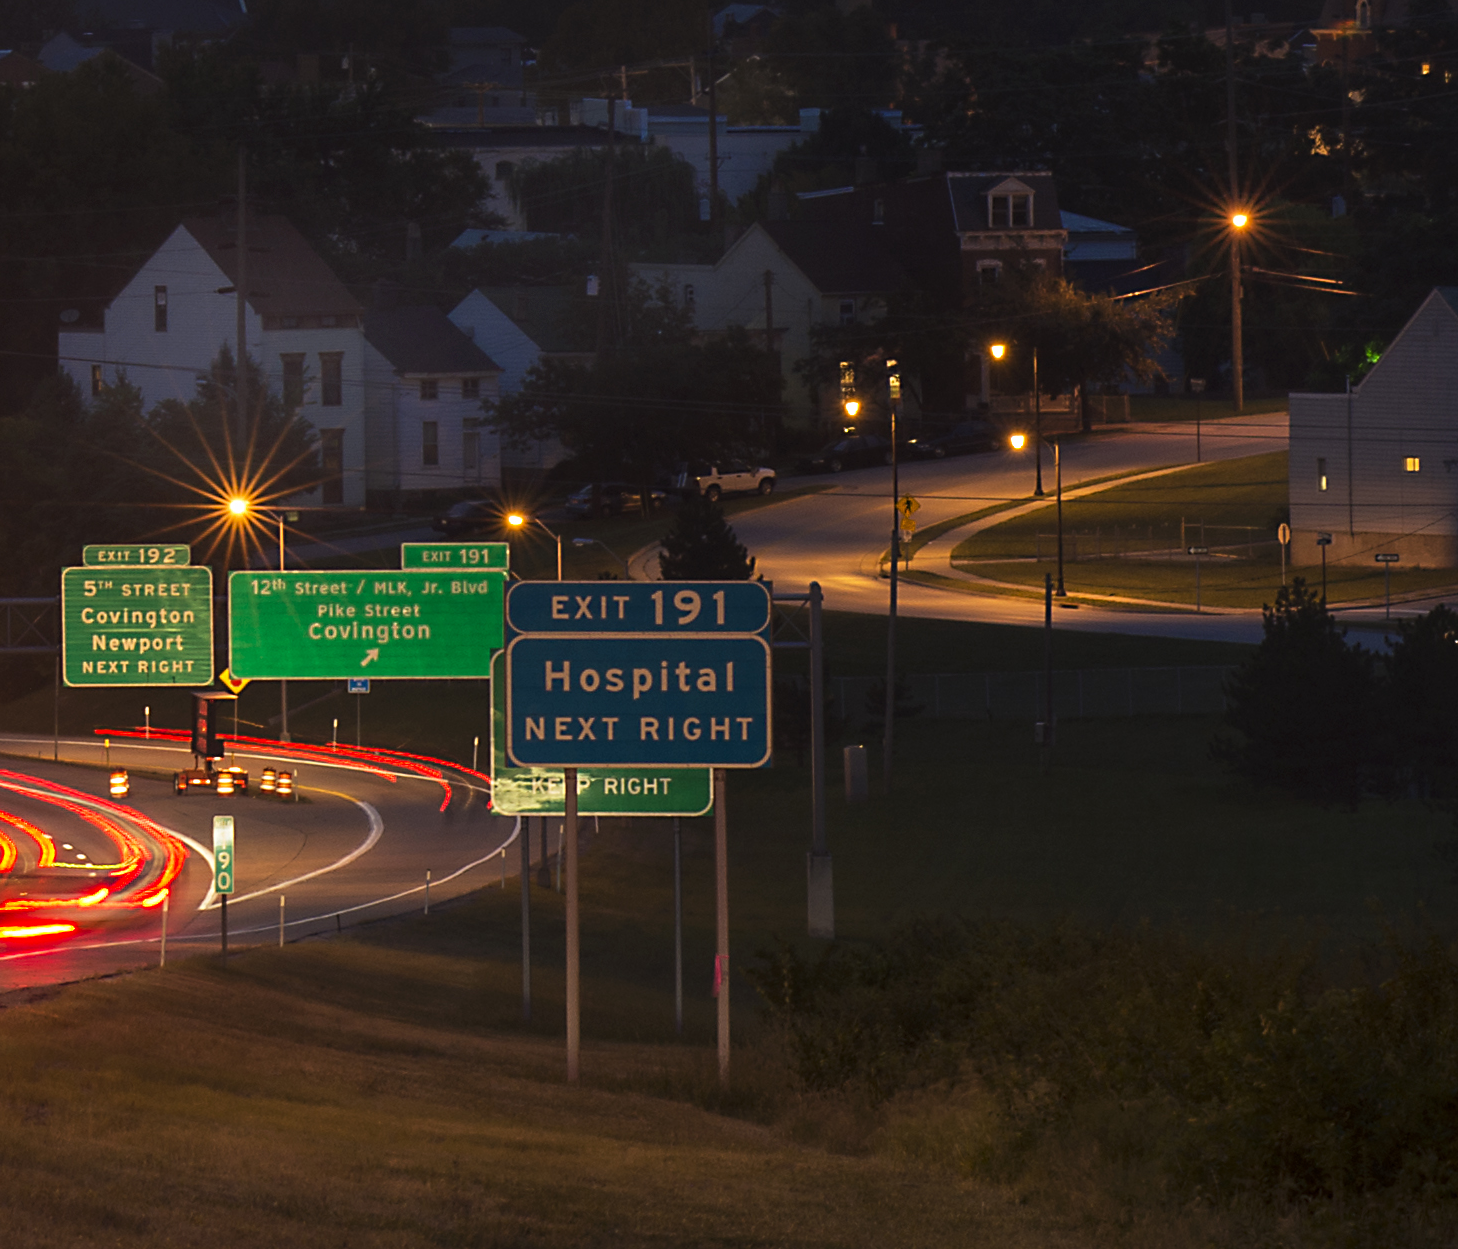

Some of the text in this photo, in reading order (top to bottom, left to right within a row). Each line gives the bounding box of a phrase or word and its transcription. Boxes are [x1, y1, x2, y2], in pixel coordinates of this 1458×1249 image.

[98, 549, 176, 563] EXIT 192
[423, 549, 489, 564] EXIT 191
[121, 583, 191, 597] STREET
[295, 582, 346, 595] Street
[421, 582, 443, 594] Jr.
[451, 580, 488, 594] Blvd
[318, 604, 420, 617] Pike Street
[551, 590, 725, 625] EXIT 191
[82, 608, 194, 628] Covington
[309, 622, 430, 643] Covington
[92, 635, 184, 654] Newport
[83, 660, 194, 674] NEXT RIGHT
[545, 661, 734, 700] Hospital
[525, 717, 753, 741] NEXT RIGHT
[532, 778, 672, 795] KEP RIGHT
